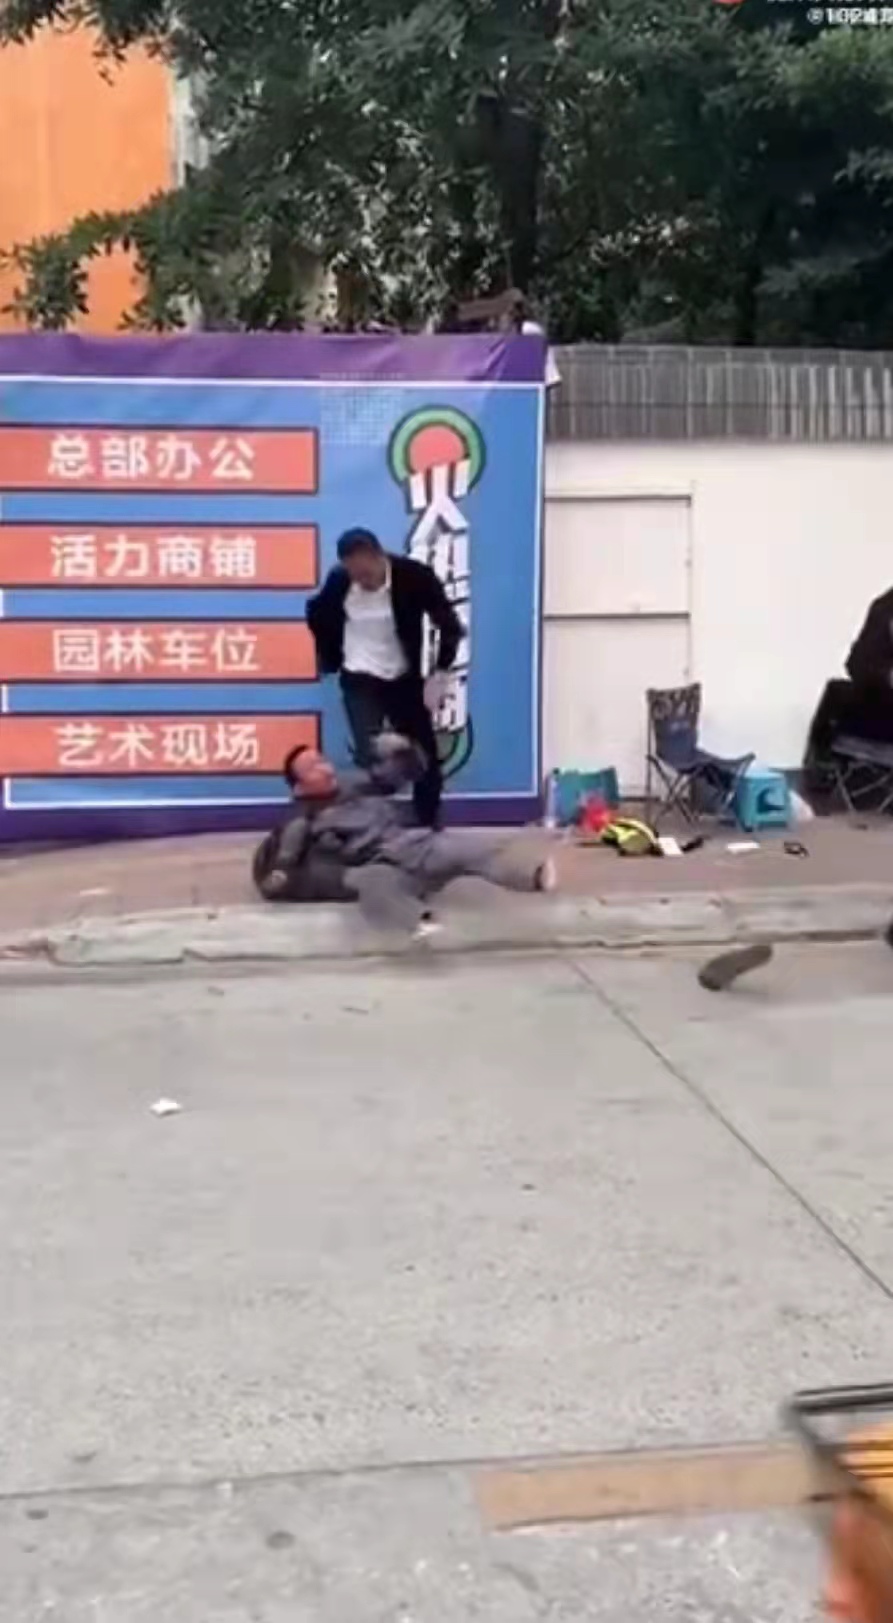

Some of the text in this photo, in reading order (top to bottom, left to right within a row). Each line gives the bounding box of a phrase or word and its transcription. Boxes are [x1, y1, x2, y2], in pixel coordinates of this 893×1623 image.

[48, 434, 255, 480] 总部办公
[50, 534, 257, 579] 活力商铺
[52, 628, 261, 673] 园林车位
[56, 722, 260, 767] 艺术现场
